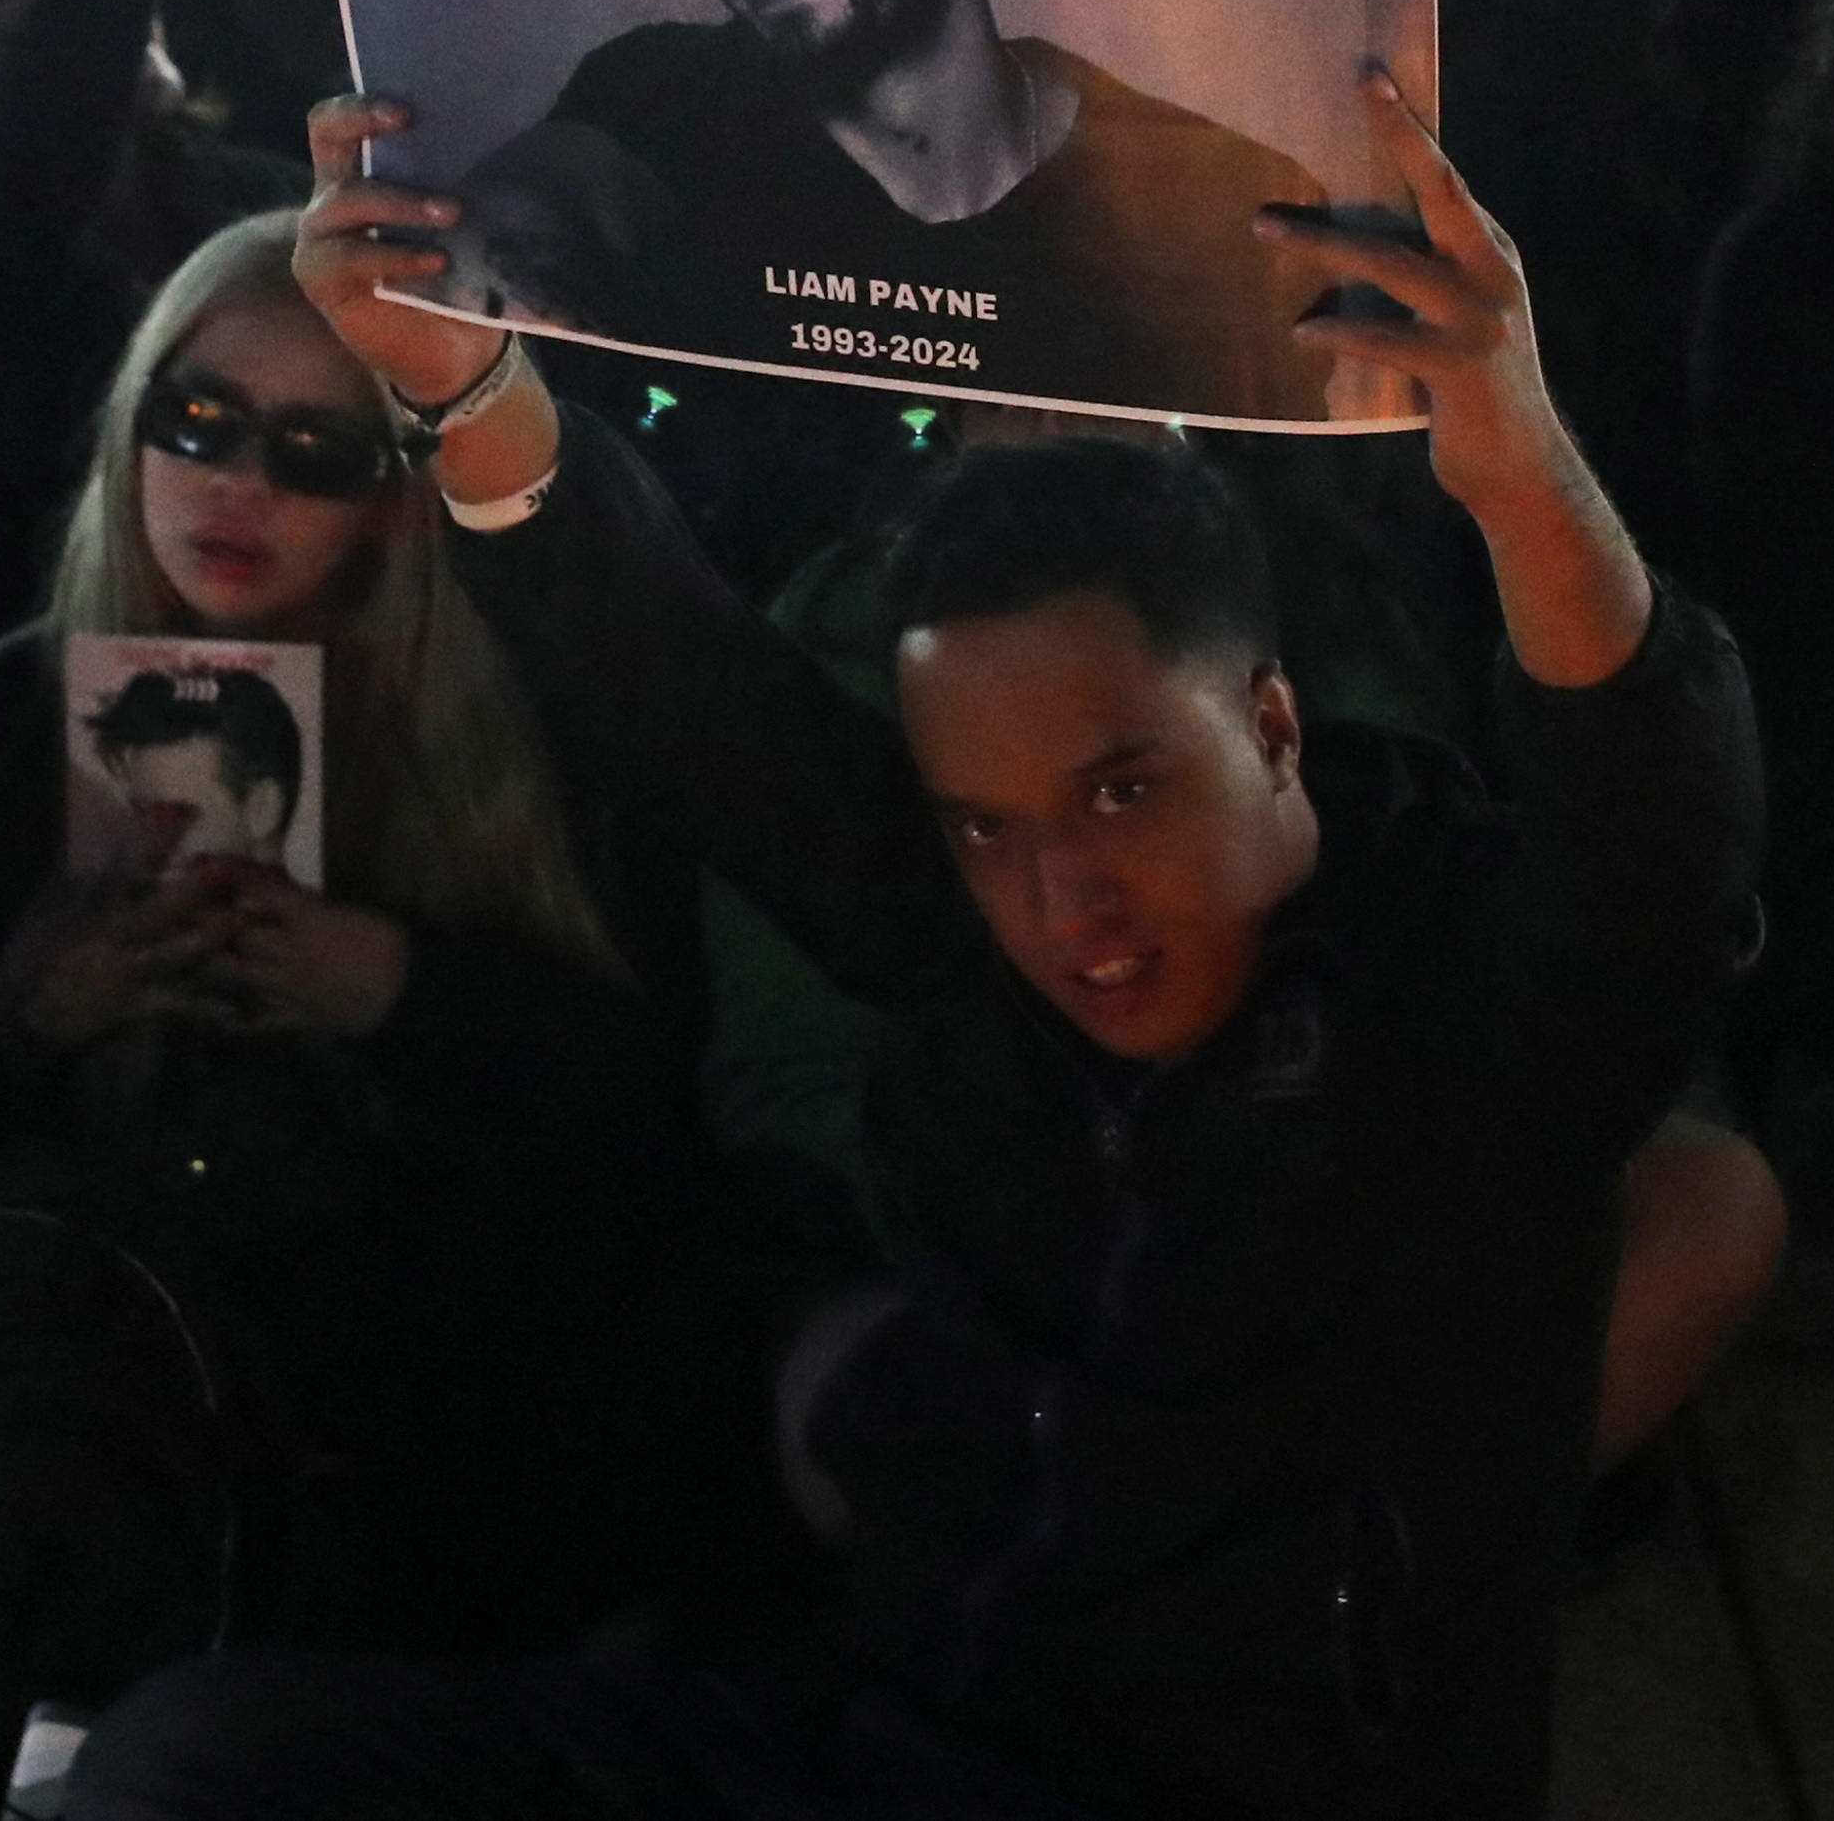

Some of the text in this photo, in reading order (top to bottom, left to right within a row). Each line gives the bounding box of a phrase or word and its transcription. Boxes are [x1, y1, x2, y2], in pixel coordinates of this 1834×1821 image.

[765, 266, 999, 321] LIAM PAYNE
[790, 322, 981, 372] 1993-2024
